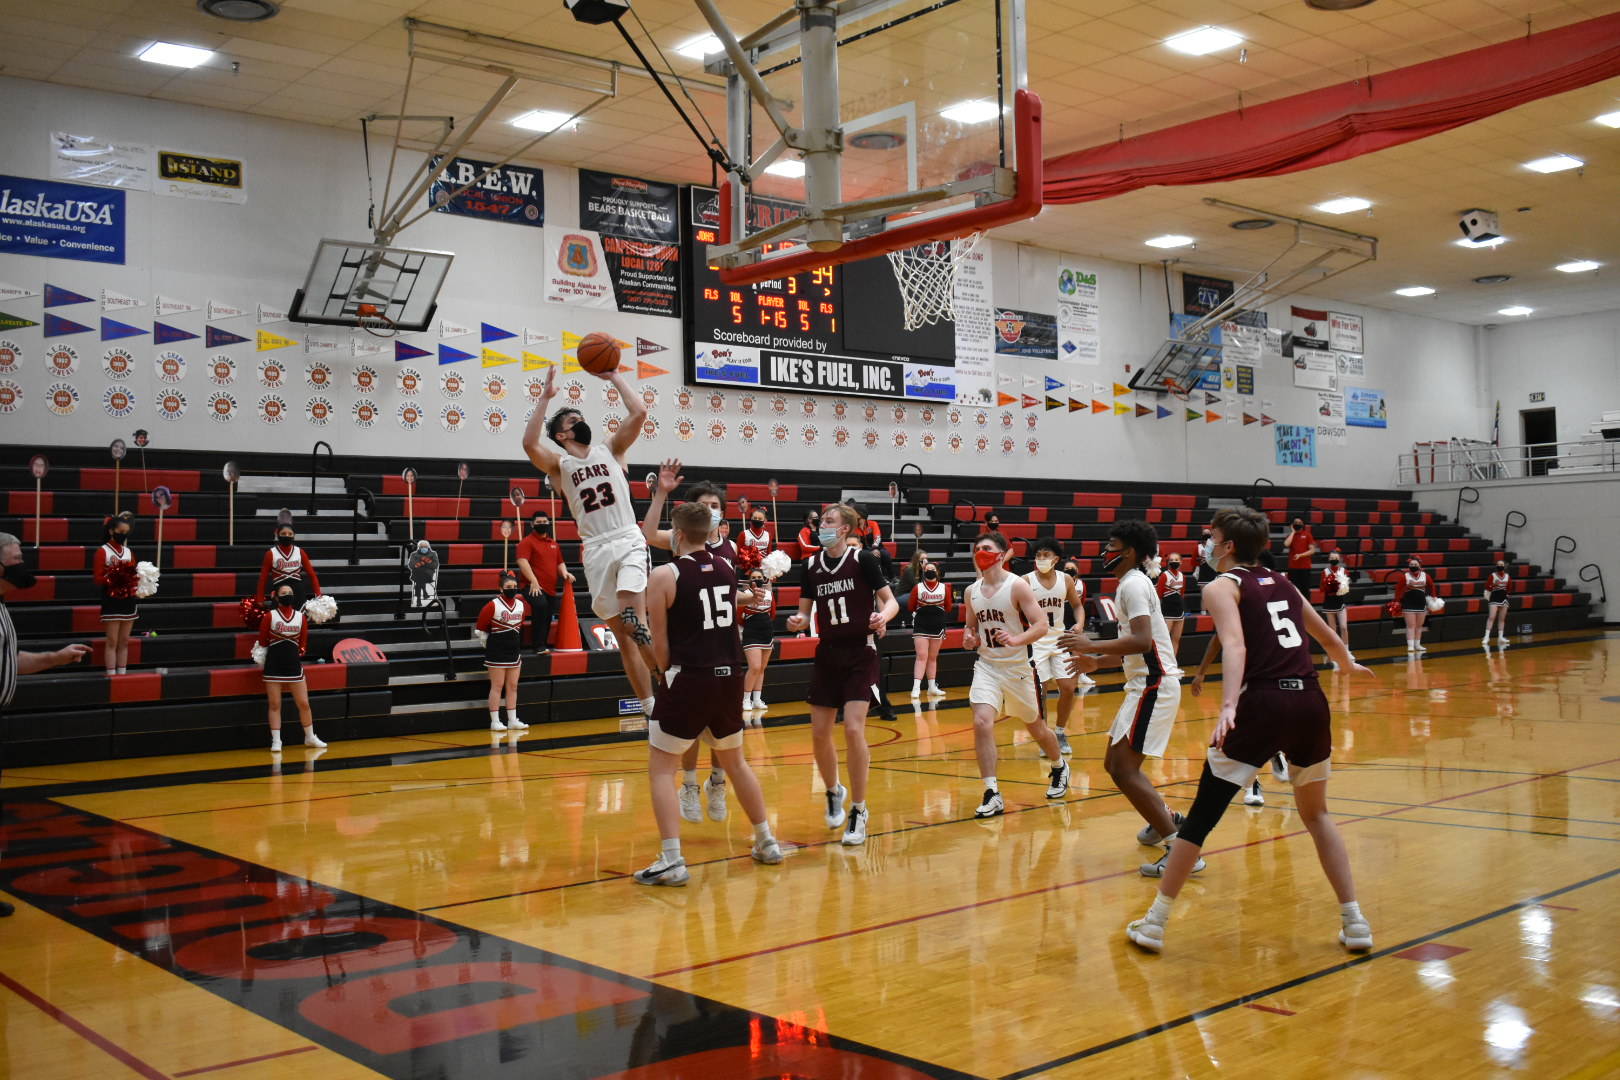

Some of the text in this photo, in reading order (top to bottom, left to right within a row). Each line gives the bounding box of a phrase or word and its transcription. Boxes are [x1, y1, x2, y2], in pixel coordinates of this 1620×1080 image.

[588, 202, 672, 223] BEARS BASKETBALL
[24, 235, 49, 246] Value
[60, 240, 116, 253] Convenience
[697, 230, 715, 242] JDHS
[621, 256, 644, 270] LOCAL
[552, 279, 576, 288] Building
[788, 277, 797, 294] 3
[704, 289, 719, 300] FLS
[730, 291, 743, 303] TOL
[758, 296, 785, 309] PLAYER
[798, 300, 811, 312] TOL
[820, 303, 833, 315] FLS
[713, 328, 828, 353] Scoreboard provided by
[769, 356, 896, 392] IKE'S FUEL, INC.
[571, 464, 610, 487] BEARS
[580, 482, 616, 514] 23
[817, 578, 855, 597] KETCHIKAN
[699, 585, 734, 630] 15
[827, 596, 850, 626] 11
[1266, 600, 1303, 648] 5
